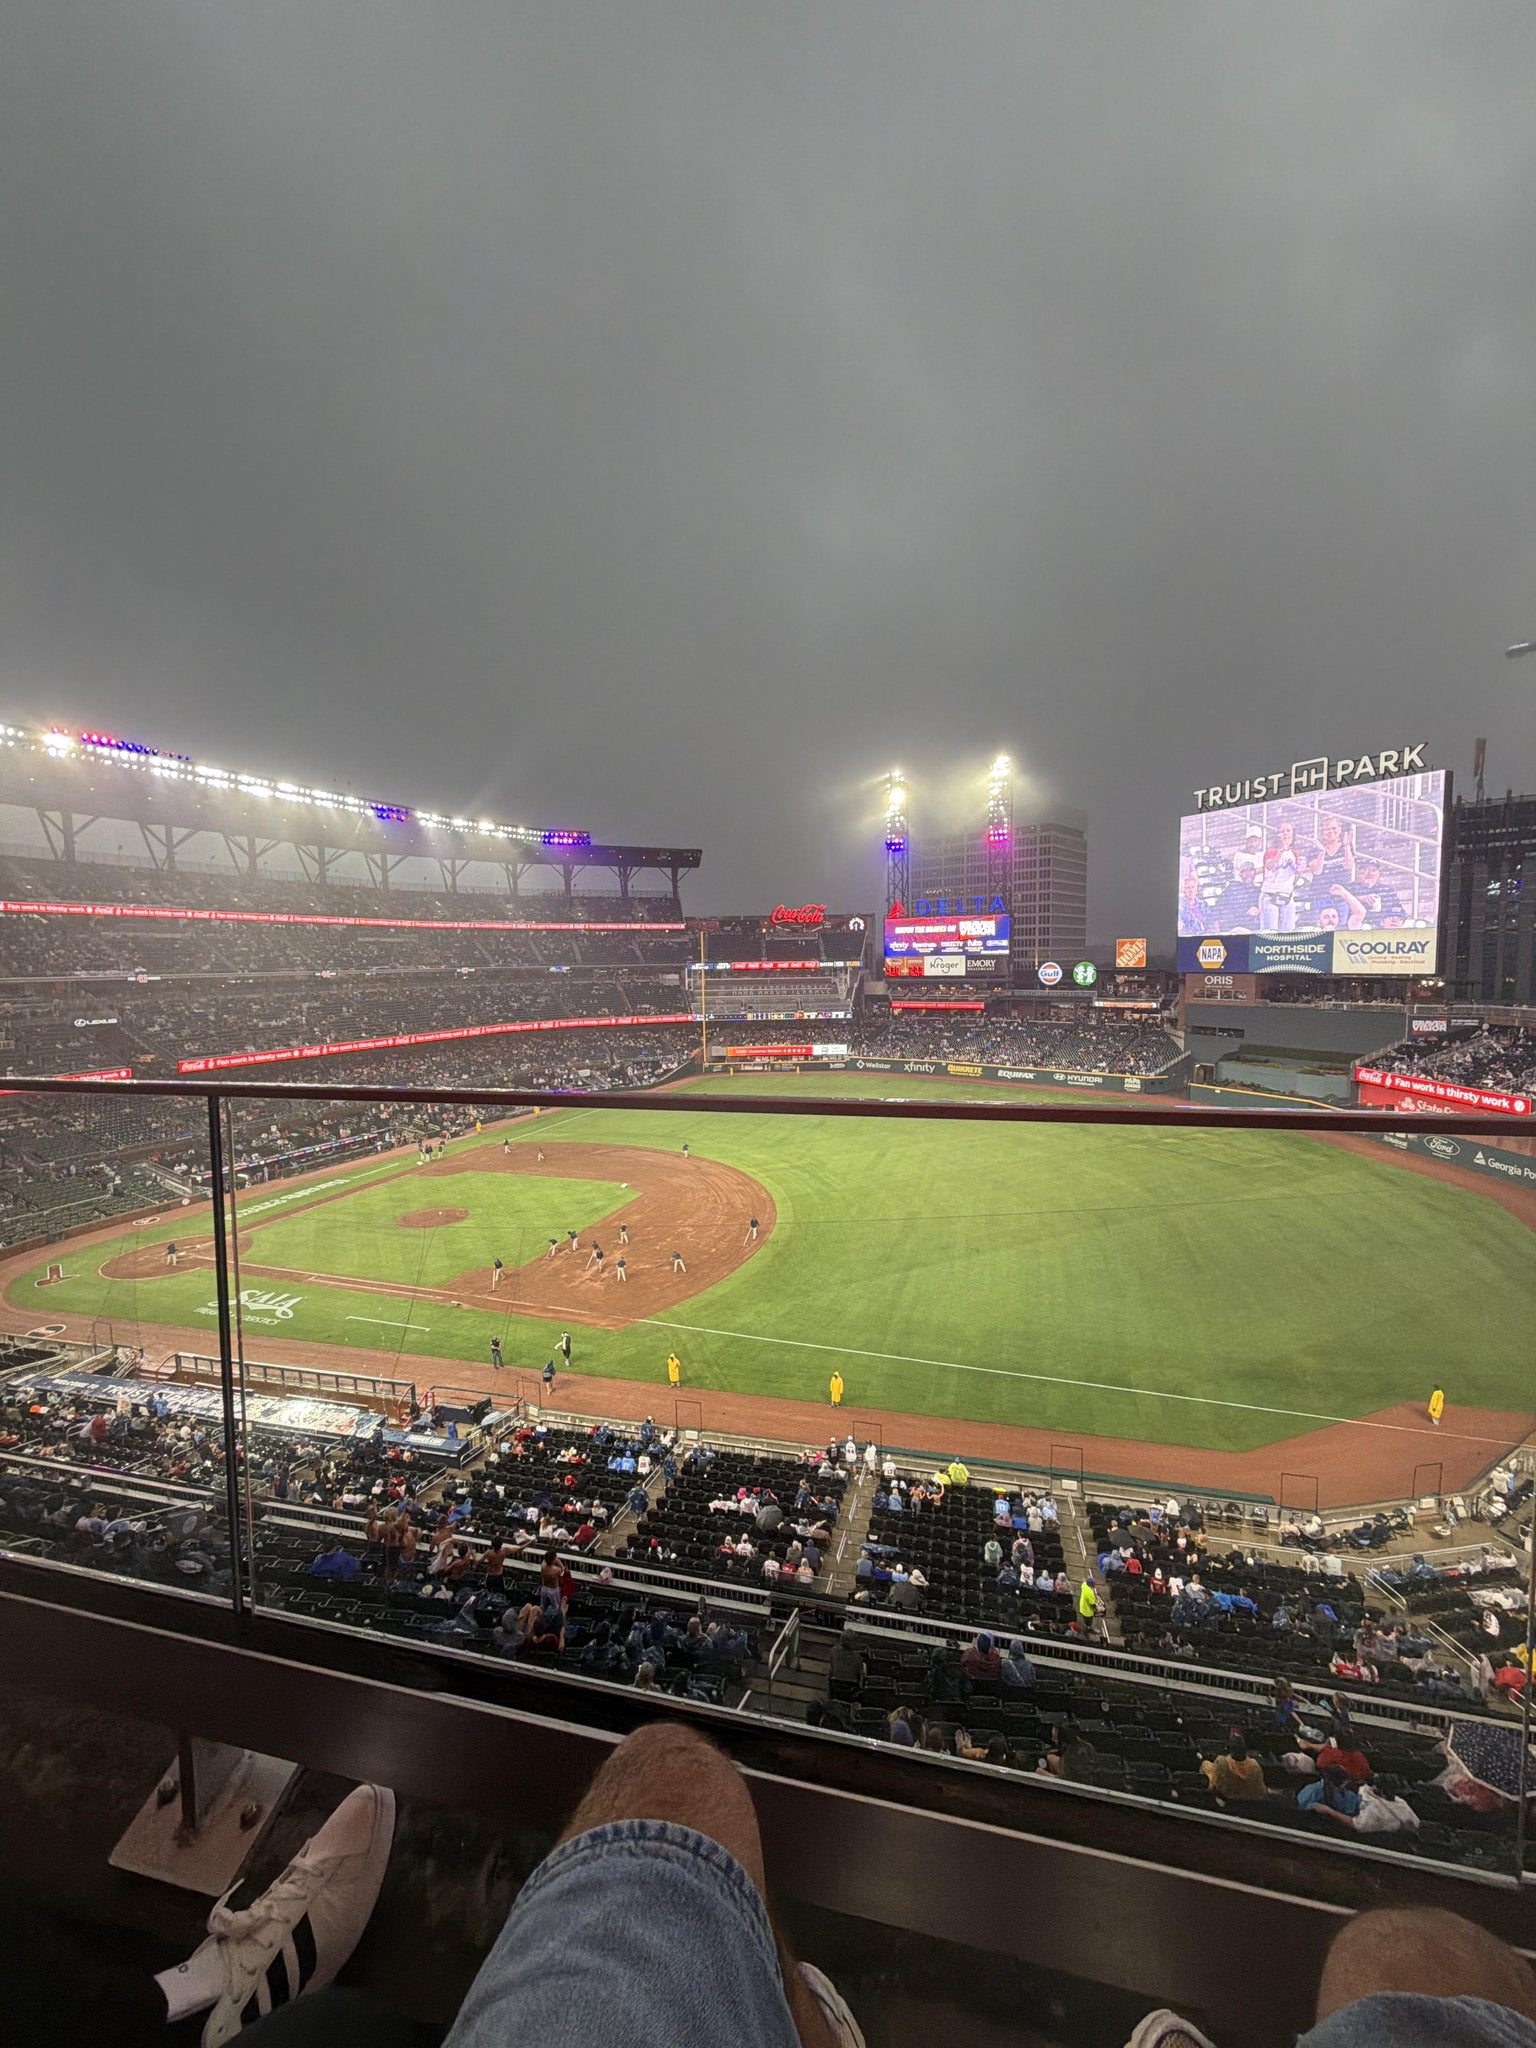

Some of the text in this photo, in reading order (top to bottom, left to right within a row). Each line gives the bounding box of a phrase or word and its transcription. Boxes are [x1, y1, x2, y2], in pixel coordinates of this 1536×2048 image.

[1193, 743, 1425, 808] TRUIST PARK
[915, 896, 1006, 915] DELTA
[770, 904, 827, 924] Coca-Cola
[1117, 939, 1145, 966] HOME
[1201, 948, 1223, 960] NAPA
[1255, 944, 1326, 954] NORTHSIDE
[1346, 940, 1430, 955] COOLRAY
[1266, 954, 1312, 962] HOSPITAL
[930, 957, 959, 974] Kroger
[1204, 975, 1234, 985] ORIS
[254, 1054, 276, 1062] thirsty
[904, 1062, 935, 1073] xfinity
[947, 1064, 983, 1074] QUIKRETE
[998, 1070, 1036, 1080] EQUIFAX
[1067, 1074, 1102, 1083] HYUNDAI
[1358, 1070, 1382, 1083] Coca-Cola
[1394, 1078, 1510, 1109] Fan work is thirsty work
[1430, 1137, 1454, 1152] Ford
[1488, 1158, 1521, 1176] Georgia
